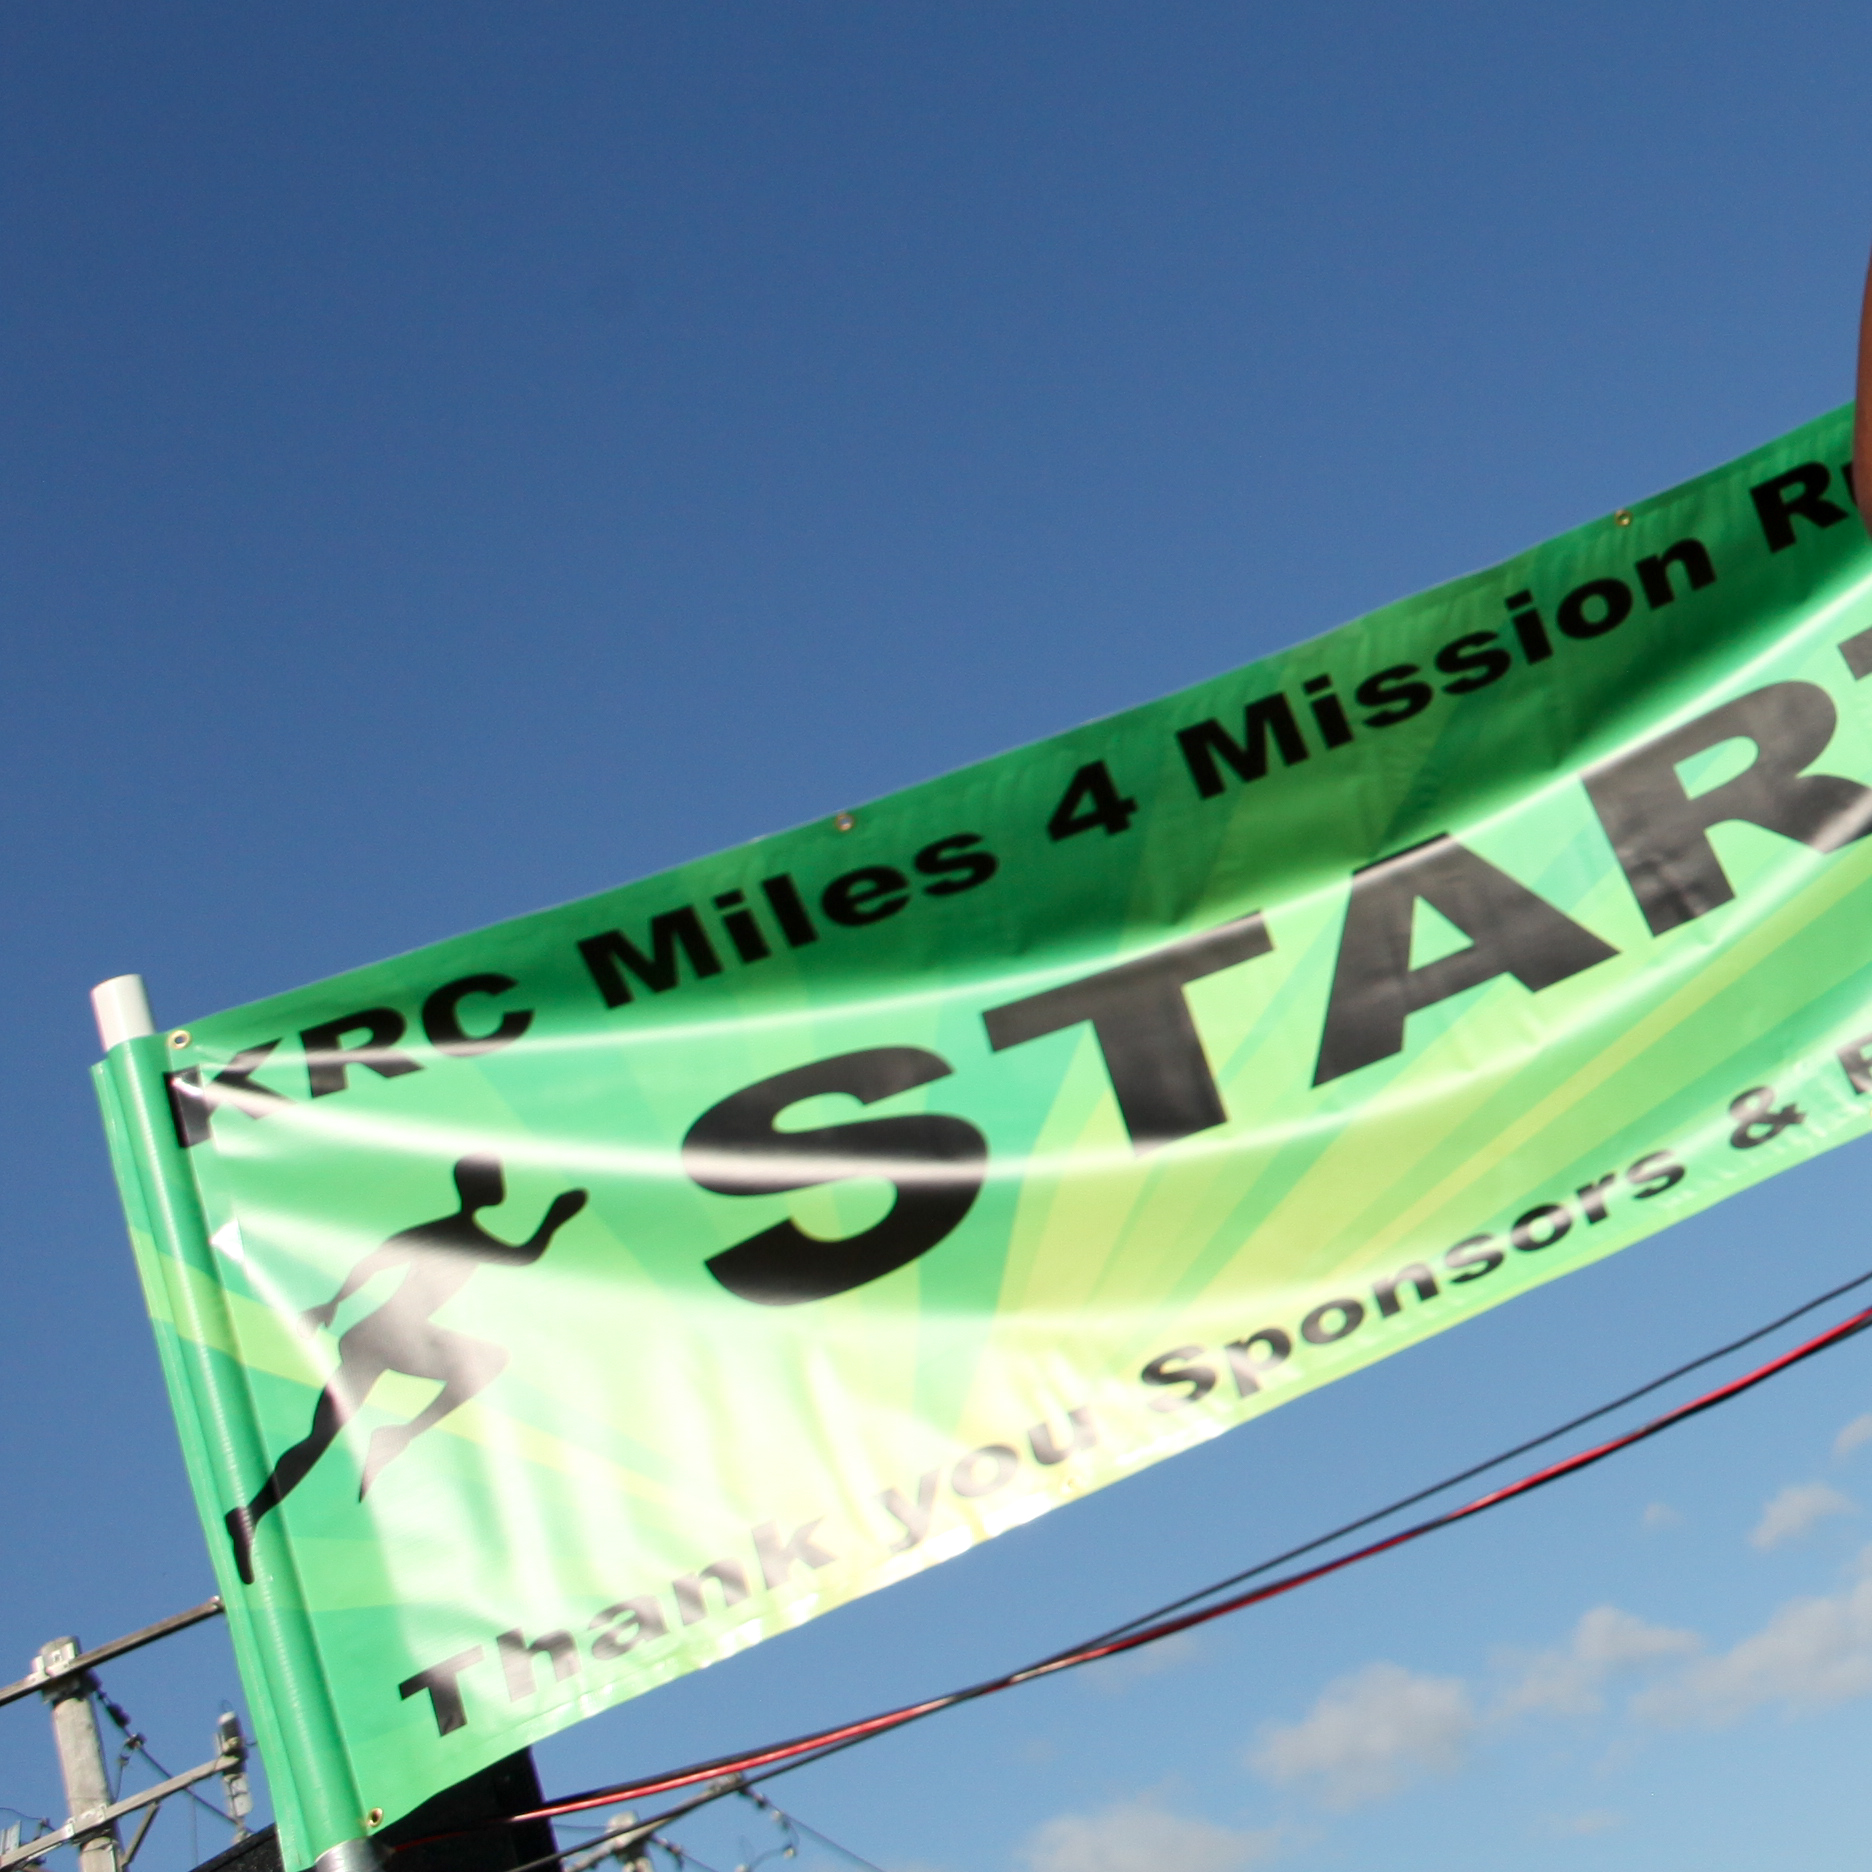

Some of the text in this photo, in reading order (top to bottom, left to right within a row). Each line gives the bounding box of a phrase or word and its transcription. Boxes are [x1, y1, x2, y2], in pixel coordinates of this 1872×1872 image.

[164, 459, 1856, 1150] KRC Miles 4 Mission R
[399, 1516, 837, 1739] Thank
[874, 1404, 1100, 1554] you
[1140, 1148, 1687, 1414] Sponsors
[1727, 1083, 1809, 1151] &
